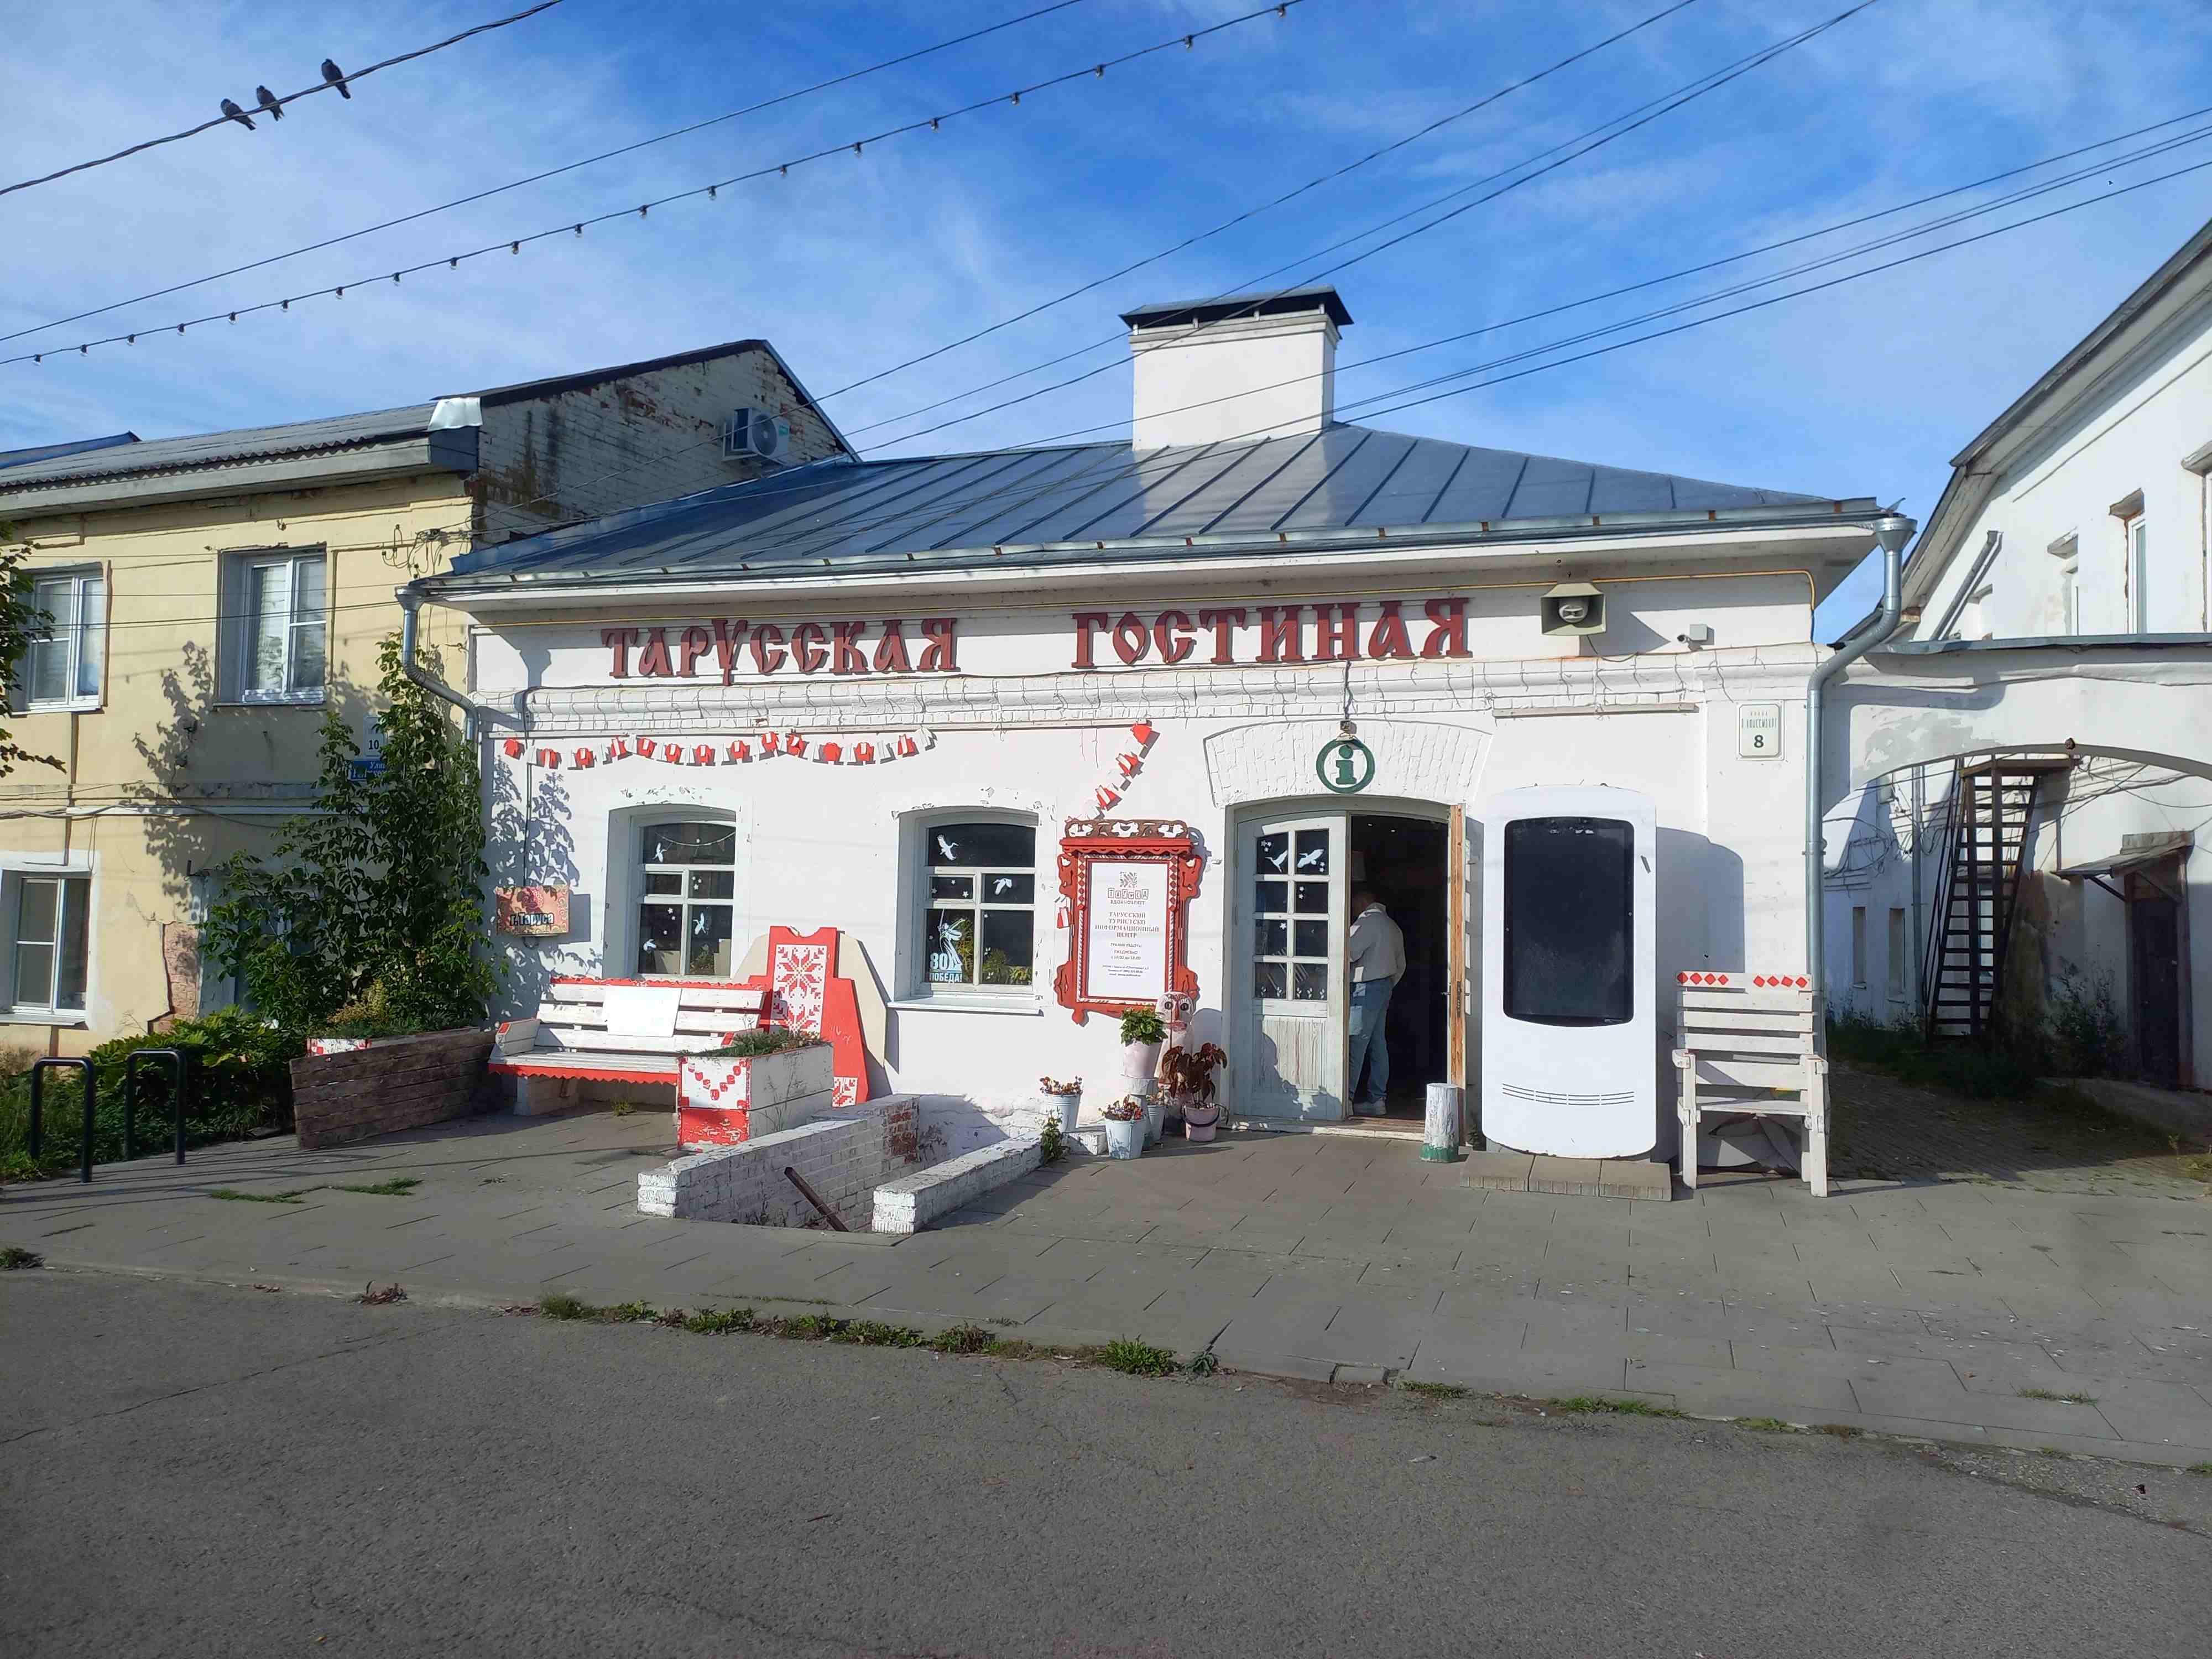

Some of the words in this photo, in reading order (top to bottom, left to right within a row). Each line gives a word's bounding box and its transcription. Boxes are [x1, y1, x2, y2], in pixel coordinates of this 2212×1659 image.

[601, 618, 960, 686] ТАРУССКАЯ
[1071, 597, 1474, 668] ГОСТИНАЯ
[368, 739, 379, 750] 10
[1754, 734, 1764, 748] 8
[1094, 924, 1159, 932] ИНФОРМАЦИОННЫЙ
[930, 952, 948, 971] 80
[929, 973, 962, 984] ПОБЕДА!
